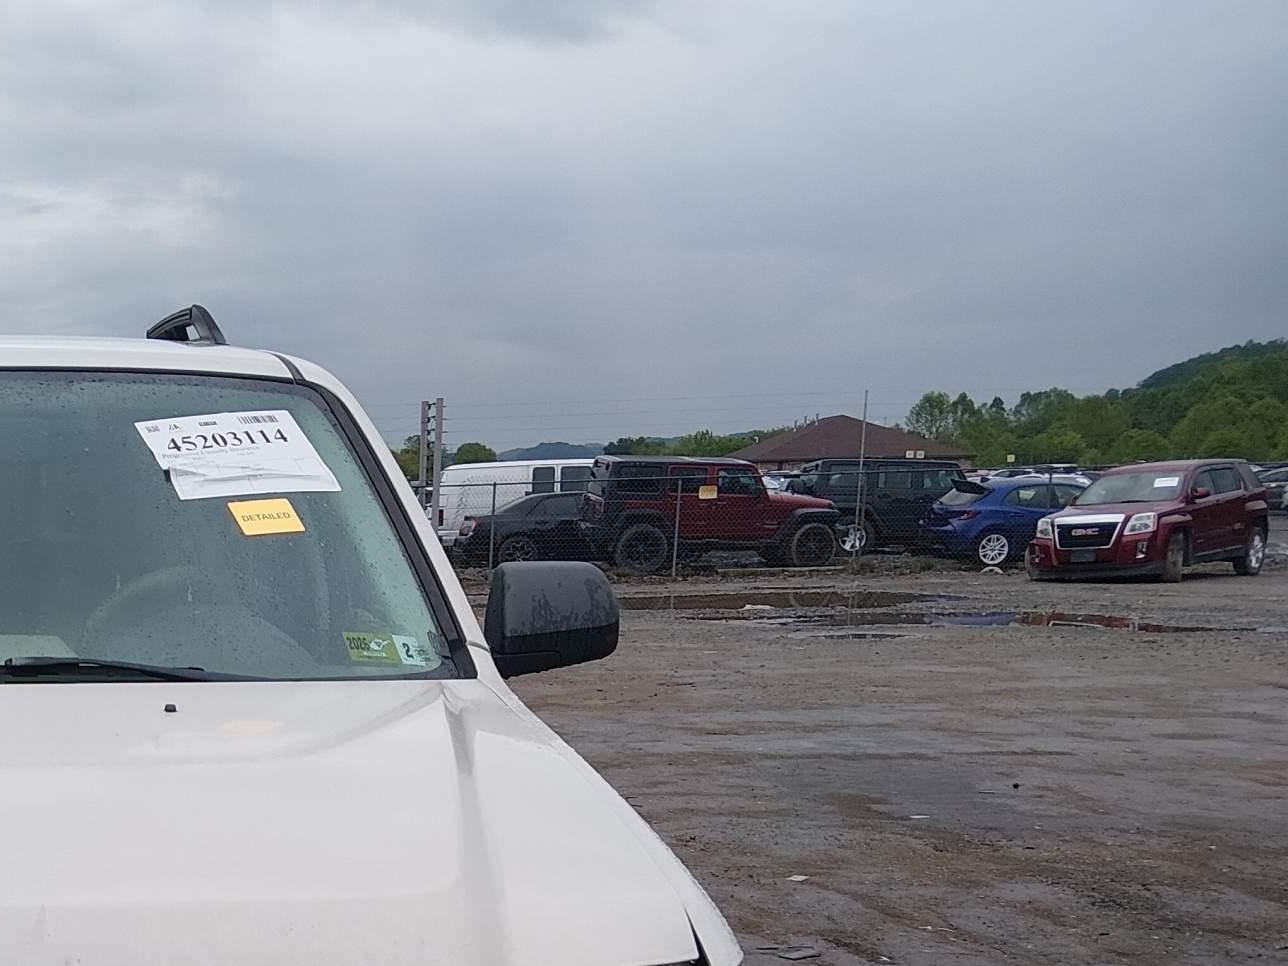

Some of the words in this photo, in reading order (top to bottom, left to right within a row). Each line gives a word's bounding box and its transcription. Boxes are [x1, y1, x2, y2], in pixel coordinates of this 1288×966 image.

[167, 428, 289, 452] 45203114
[241, 511, 291, 523] DETAILED
[1071, 527, 1100, 536] GMC
[402, 642, 414, 659] 2
